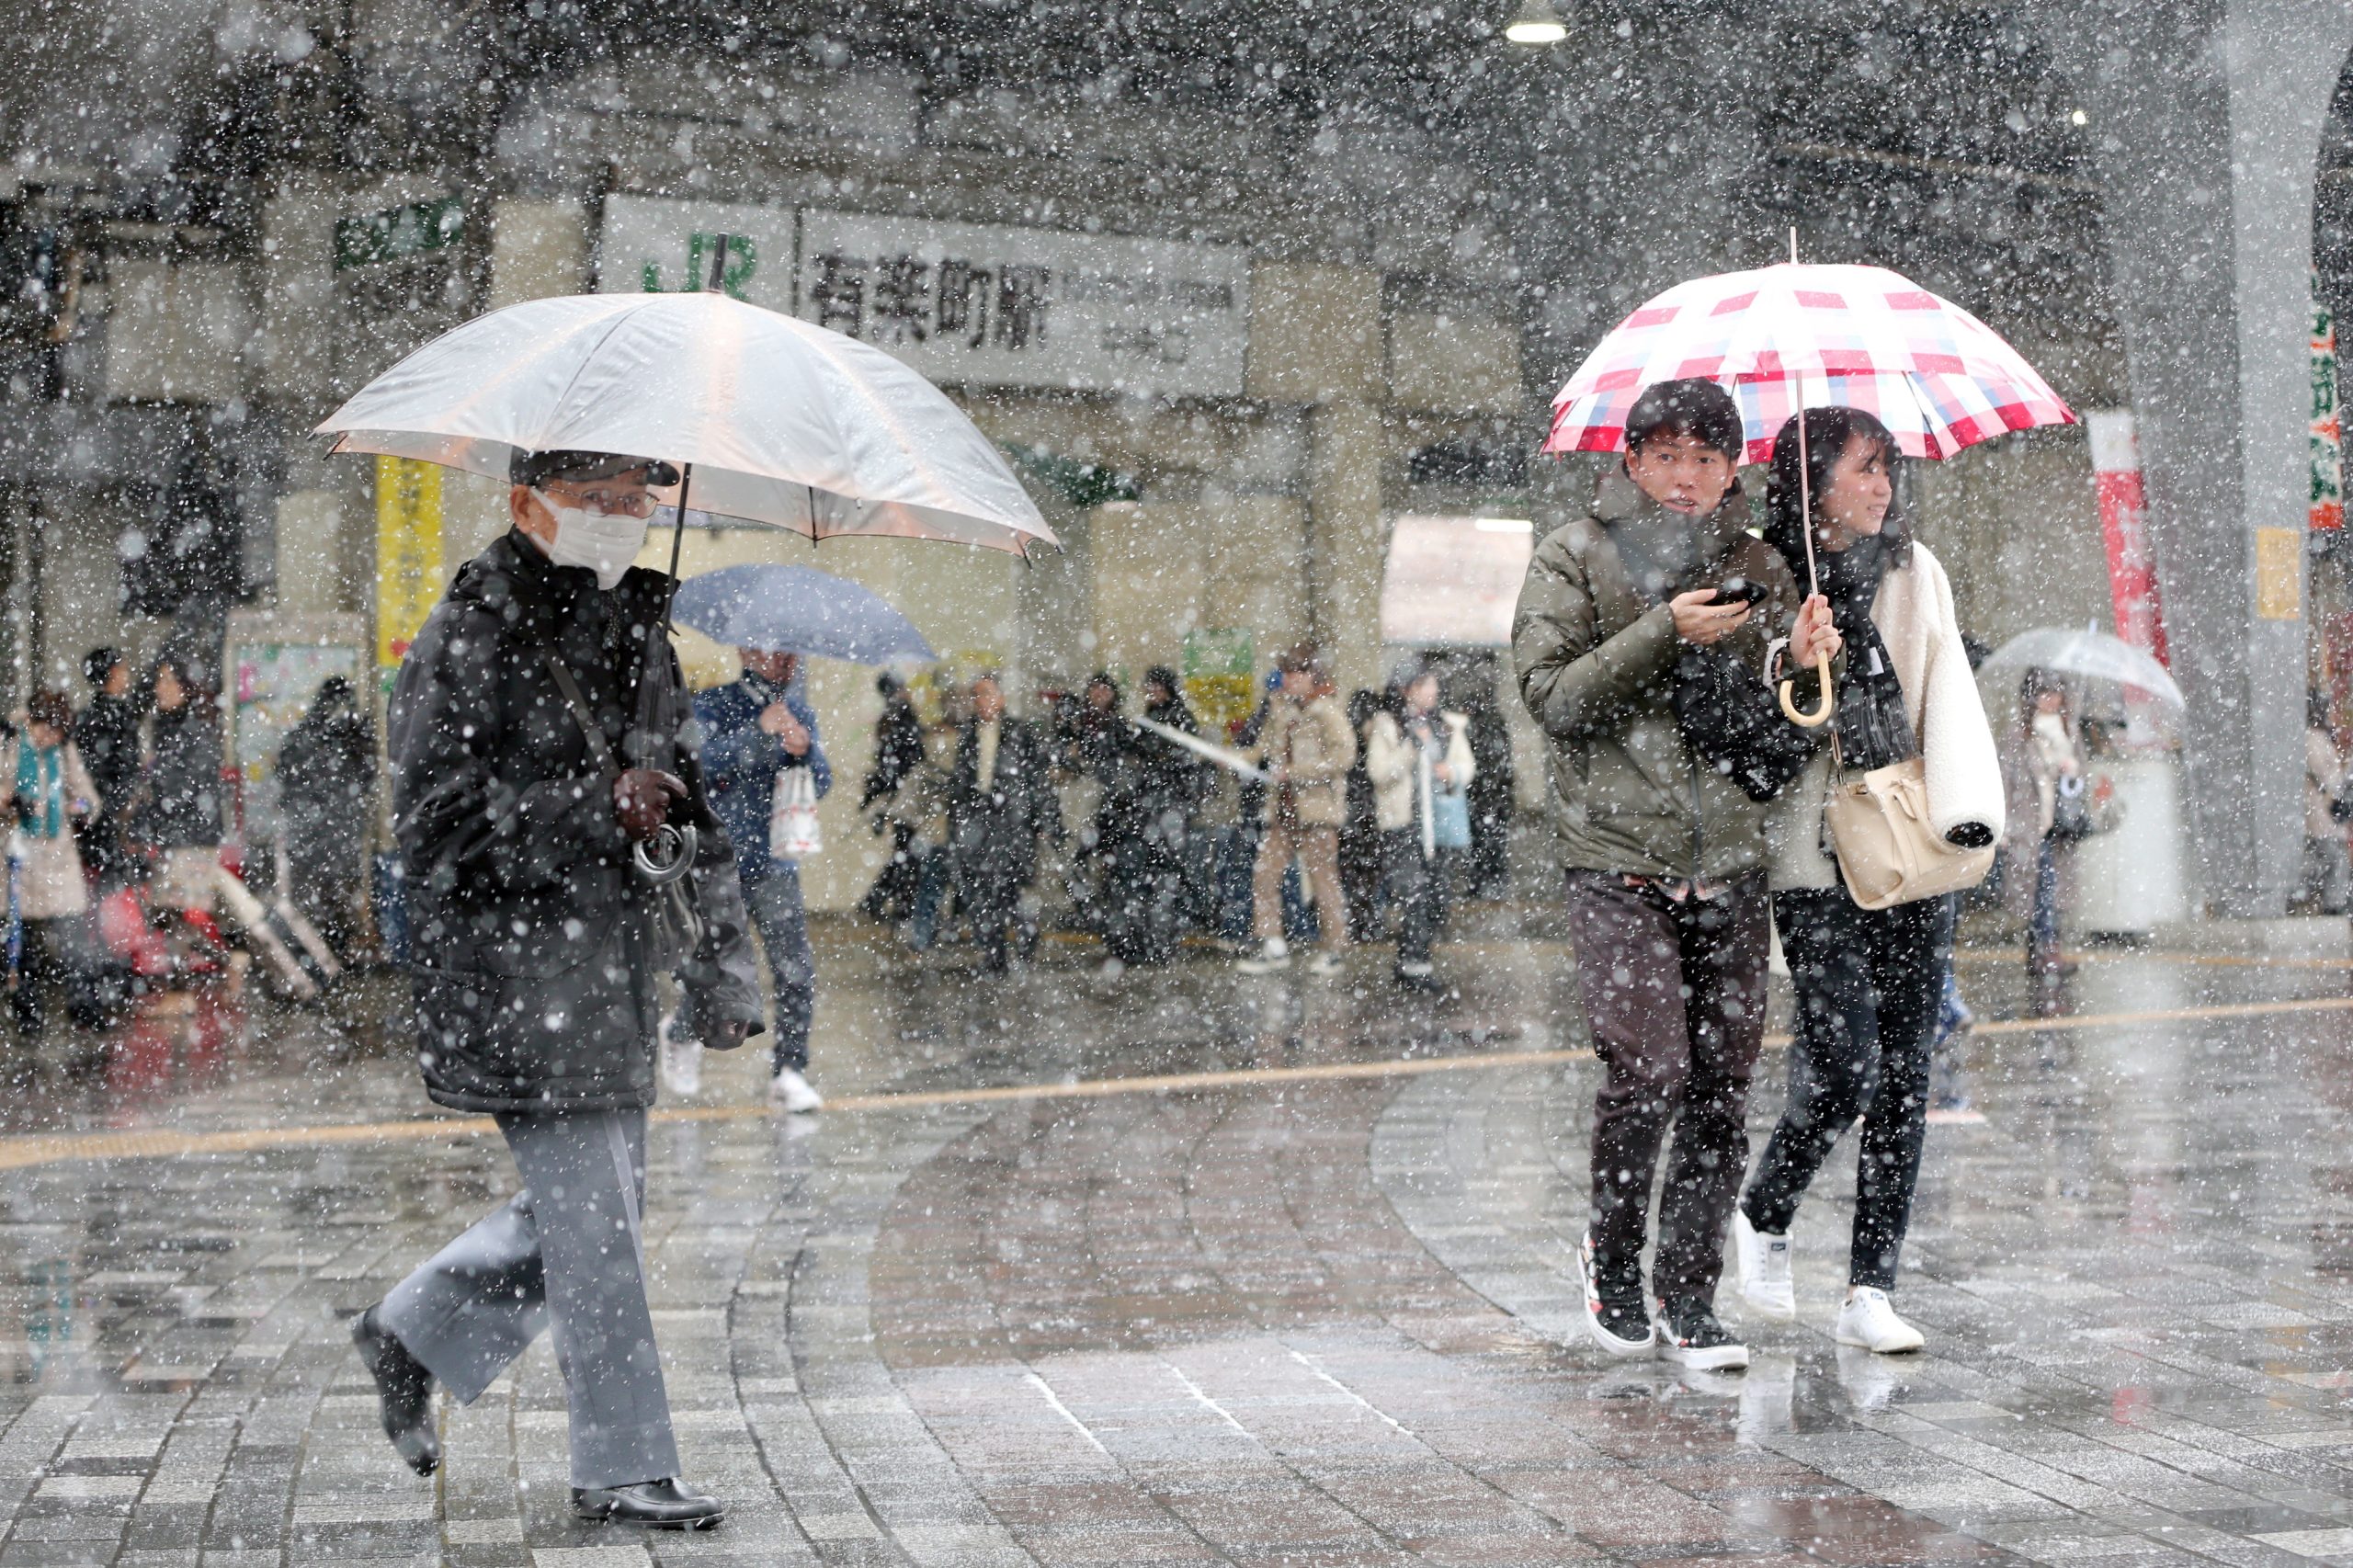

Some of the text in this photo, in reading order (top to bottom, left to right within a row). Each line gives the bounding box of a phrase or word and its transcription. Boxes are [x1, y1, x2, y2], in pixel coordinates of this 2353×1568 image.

[642, 232, 756, 301] JR
[811, 249, 1053, 352] 有楽町駅
